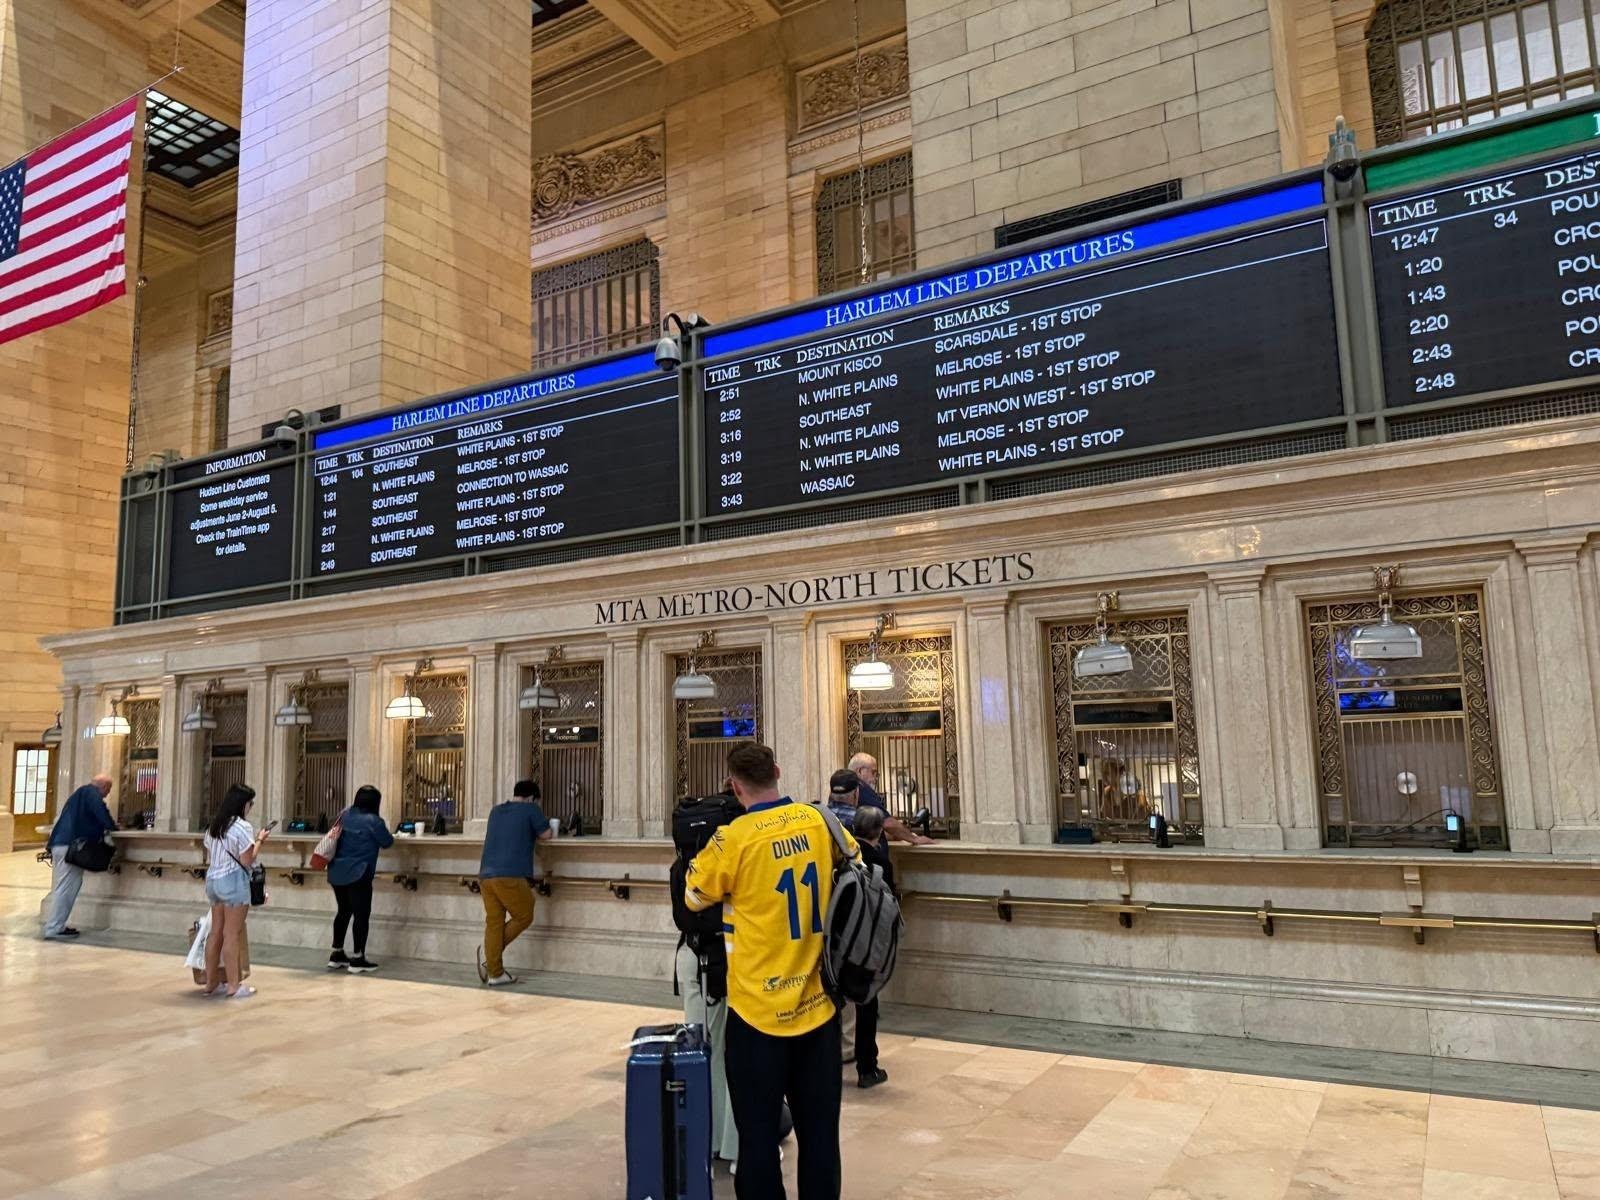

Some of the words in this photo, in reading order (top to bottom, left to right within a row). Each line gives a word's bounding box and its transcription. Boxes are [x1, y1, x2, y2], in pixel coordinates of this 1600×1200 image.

[1378, 199, 1437, 225] TIME
[1463, 181, 1516, 205] TRK
[1392, 227, 1439, 250] 12:47
[1494, 210, 1518, 228] 34
[825, 290, 911, 327] HARLEM
[916, 275, 969, 302] LINE
[975, 232, 1135, 288] DEPARTURES
[1405, 257, 1442, 276] 1:20
[1408, 285, 1445, 304] 1:43
[708, 366, 740, 382] TIME
[755, 356, 781, 372] TRK
[796, 329, 893, 363] DESTINATION
[934, 301, 1009, 331] REMARKS
[1410, 314, 1448, 334] 2:20
[720, 387, 739, 401] 2:51
[797, 364, 841, 383] MOUNT
[844, 355, 881, 374] KISCO
[935, 323, 1018, 353] SCARSDALE
[1031, 313, 1057, 331] 1ST
[1061, 304, 1101, 324] STOP
[1413, 344, 1452, 363] 2:43
[721, 409, 741, 422] 2:52
[799, 393, 810, 406] N.
[813, 384, 851, 403] WHITE
[855, 374, 897, 394] PLAINS
[936, 351, 1002, 376] MELROSE
[1015, 342, 1041, 359] 1ST
[1045, 333, 1085, 353] STOP
[721, 430, 741, 443] 3:16
[800, 403, 872, 428] SOUTHEAST
[936, 380, 980, 399] WHITE
[984, 369, 1034, 390] PLAINS
[1047, 360, 1074, 377] 1ST
[1078, 351, 1120, 371] STOP
[1416, 373, 1455, 392] 2:48
[392, 406, 445, 430] HARLEM
[448, 397, 479, 417] LINE
[483, 374, 575, 409] DEPARTURES
[721, 451, 741, 464] 3:19
[800, 437, 811, 450] N.
[814, 429, 852, 446] WHITE
[856, 421, 899, 439] PLAINS
[938, 409, 957, 424] MT
[960, 396, 1019, 419] VERNON
[1023, 387, 1066, 407] WEST
[1080, 378, 1108, 396] 1ST
[1112, 370, 1155, 390] STOP
[206, 450, 265, 474] INFORMATION
[318, 457, 338, 470] TIME
[347, 451, 363, 463] TRK
[373, 437, 433, 458] DESTINATION
[458, 420, 502, 439] REMARKS
[321, 474, 337, 486] 12:44
[352, 469, 363, 478] 104
[373, 456, 419, 474] SOUTHEAST
[457, 439, 483, 455] WHITE
[486, 436, 515, 450] PLAINS
[523, 431, 538, 443] 1ST
[540, 426, 563, 440] STOP
[721, 472, 742, 486] 3:22
[801, 460, 811, 471] N.
[815, 452, 853, 469] WHITE
[856, 444, 900, 462] PLAINS
[938, 424, 1005, 448] MELROSE
[1018, 417, 1044, 433] 1ST
[1048, 410, 1088, 428] STOP
[722, 494, 742, 507] 3:43
[801, 474, 854, 494] WASSAIC
[939, 453, 982, 471] WHITE
[987, 444, 1037, 463] PLAINS
[1050, 436, 1077, 452] 1ST
[1082, 429, 1123, 448] STOP
[200, 486, 222, 498] Hudson
[223, 483, 236, 492] Line
[237, 474, 270, 489] Customers
[324, 492, 336, 502] 1:21
[373, 483, 380, 492] N.
[382, 476, 406, 490] WHITE
[408, 471, 435, 485] PLAINS
[457, 458, 497, 475] MELROSE
[505, 453, 520, 465] 1ST
[522, 449, 545, 462] STOP
[373, 492, 418, 509] SOUTHEAST
[457, 474, 512, 493] CONNECTION
[514, 471, 526, 483] TO
[528, 464, 568, 480] WASSAIC
[191, 516, 225, 530] adjustments
[226, 513, 241, 523] June
[242, 505, 269, 519] 2-August
[201, 503, 217, 513] Some
[218, 496, 245, 508] weekday
[246, 491, 268, 503] service
[322, 525, 336, 536] 2:17
[372, 510, 418, 527] SOUTHEAST
[457, 498, 483, 511] WHITE
[485, 493, 515, 507] PLAINS
[523, 488, 538, 500] 1ST
[540, 484, 564, 497] STOP
[196, 532, 215, 544] Check
[216, 531, 225, 540] the
[226, 525, 256, 538] TrainTime
[258, 523, 269, 533] app
[216, 546, 224, 555] for
[225, 542, 246, 554] details.
[321, 560, 335, 570] 2:49
[371, 546, 417, 562] SOUTHEAST
[456, 535, 483, 548] WHITE
[485, 530, 515, 544] PLAINS
[523, 527, 538, 538] 1ST
[540, 523, 564, 536] STOP
[322, 542, 334, 552] 2:21
[372, 535, 379, 544] N.
[380, 530, 405, 542] WHITE
[406, 525, 434, 538] PLAINS
[457, 514, 497, 530] MELROSE
[504, 511, 520, 522] 1ST
[522, 507, 545, 520] STOP
[596, 602, 648, 625] MTA
[658, 572, 876, 619] METRO-NORTH
[888, 552, 1034, 593] TICKETS
[772, 834, 810, 860] DUNN
[776, 862, 822, 940] 11
